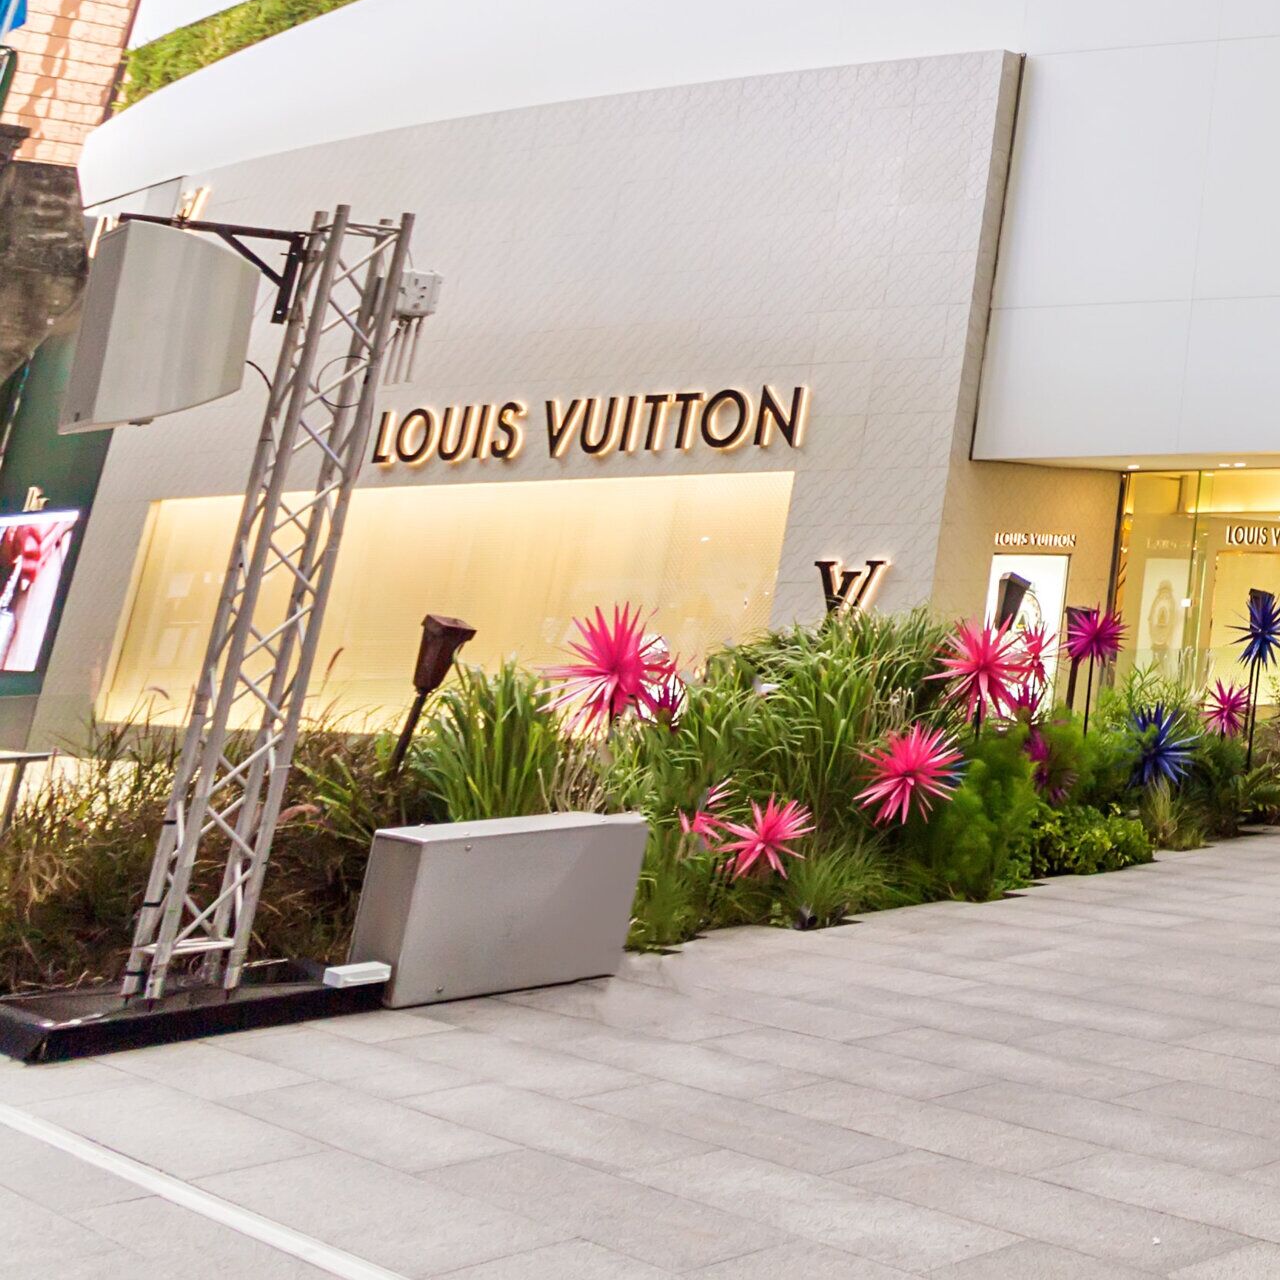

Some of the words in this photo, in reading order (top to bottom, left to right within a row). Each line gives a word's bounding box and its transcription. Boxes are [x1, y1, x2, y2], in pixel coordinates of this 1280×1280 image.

[371, 401, 526, 464] LOUIS
[545, 384, 809, 459] VUITTON
[994, 532, 1028, 546] LOUIS
[1225, 525, 1268, 546] LOUIS
